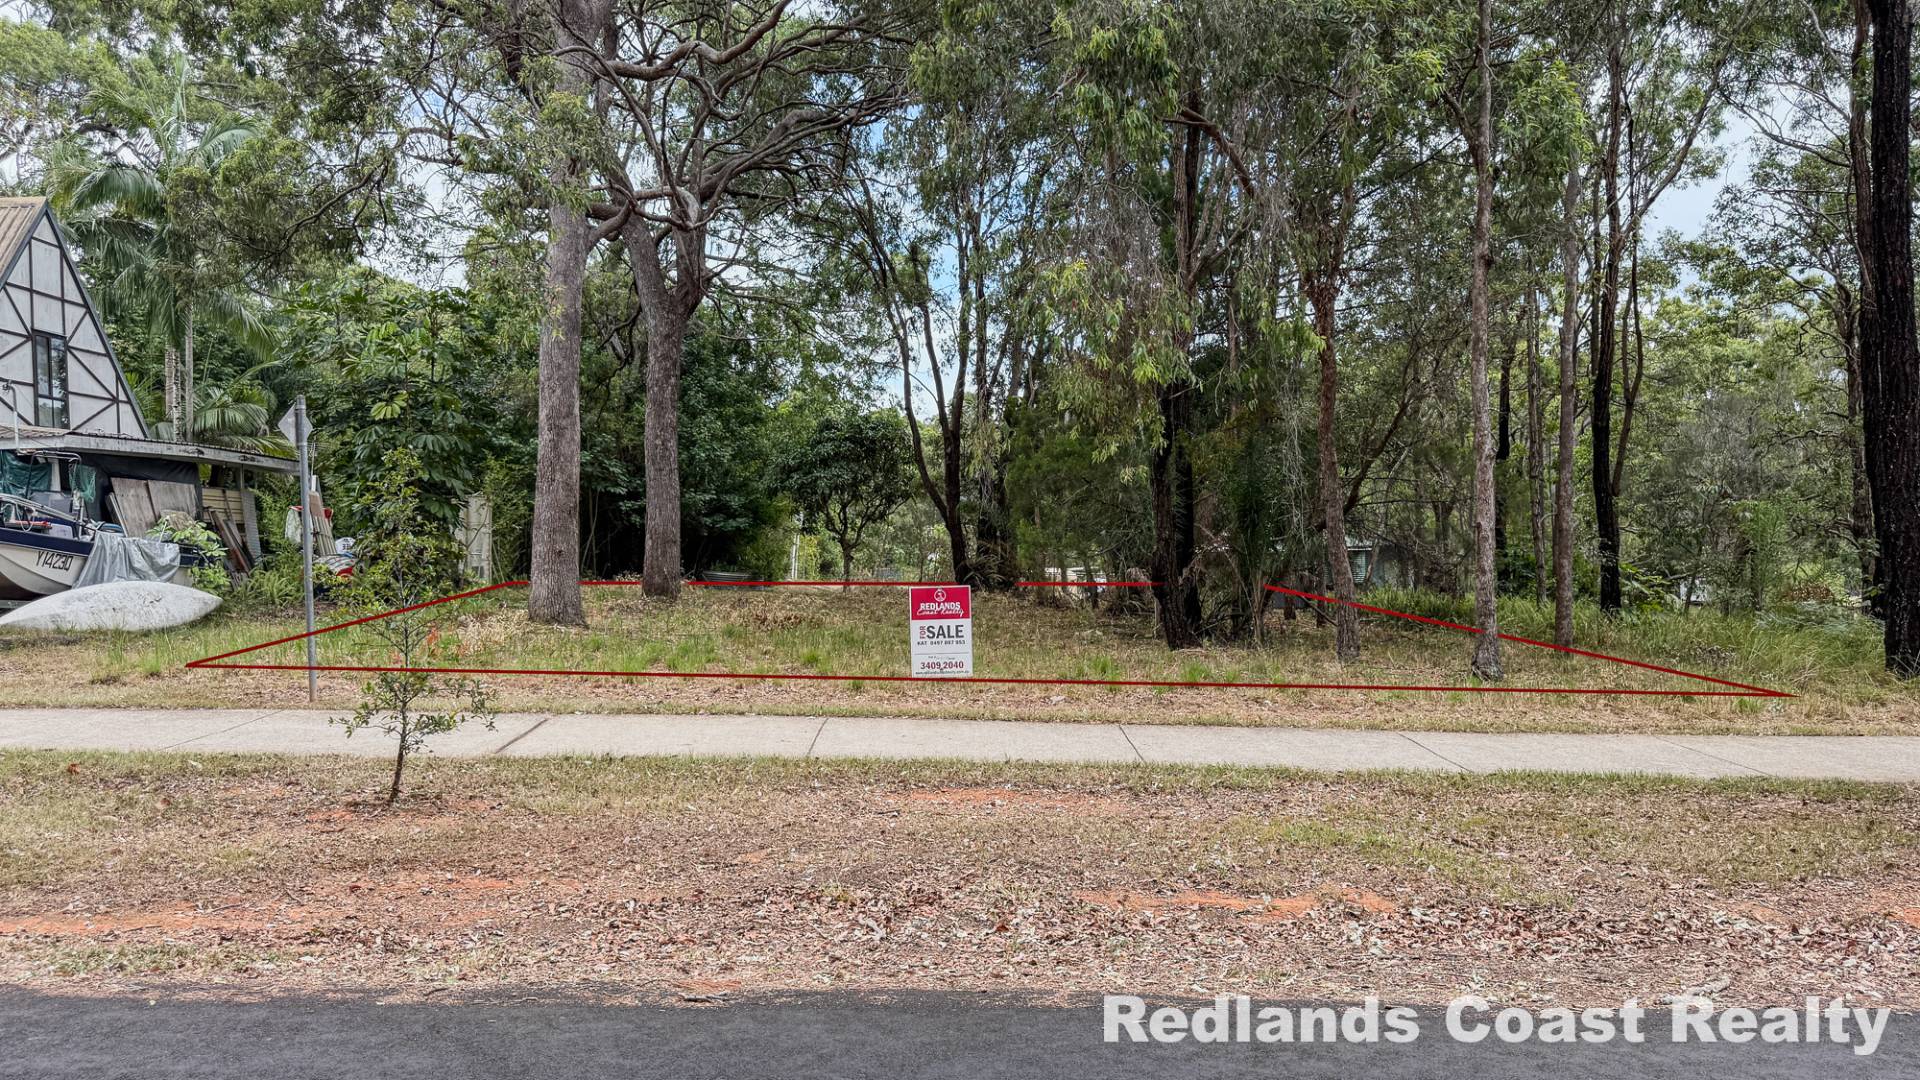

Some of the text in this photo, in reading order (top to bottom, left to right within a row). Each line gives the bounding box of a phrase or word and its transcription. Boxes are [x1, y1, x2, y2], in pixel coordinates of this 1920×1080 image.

[920, 602, 960, 611] REDLANDS
[926, 625, 964, 639] SALE
[920, 660, 964, 670] 3409 2040
